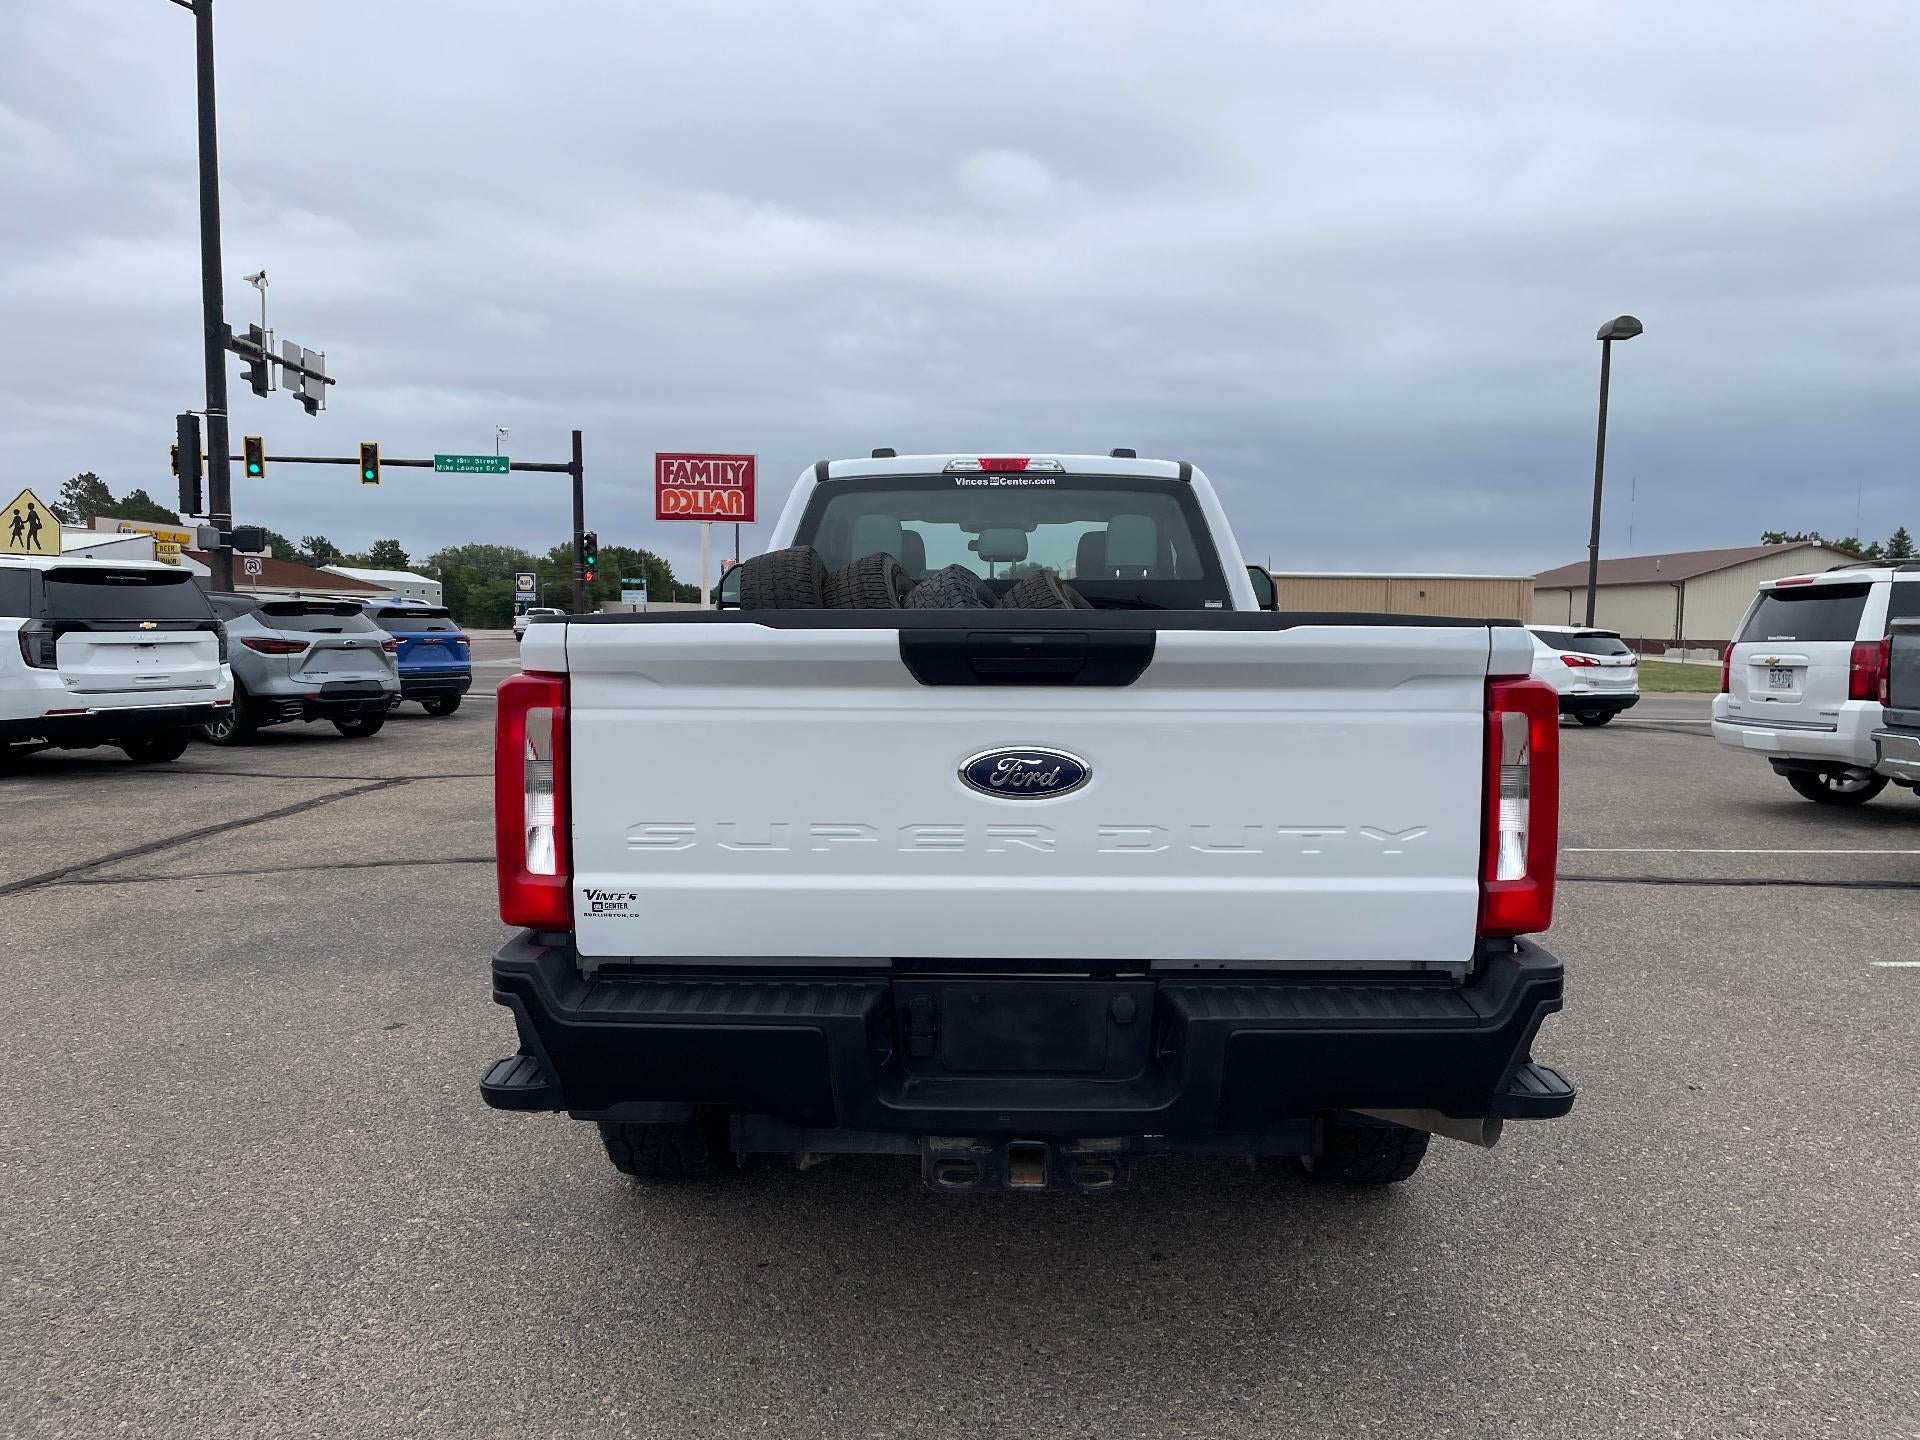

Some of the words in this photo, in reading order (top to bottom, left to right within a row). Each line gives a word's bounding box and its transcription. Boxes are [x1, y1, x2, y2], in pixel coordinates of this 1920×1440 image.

[661, 459, 748, 486] FAMILY
[661, 488, 745, 516] DOLLAR
[988, 757, 1061, 787] Ford
[626, 821, 1057, 853] SUPER
[1097, 823, 1429, 855] DUTY
